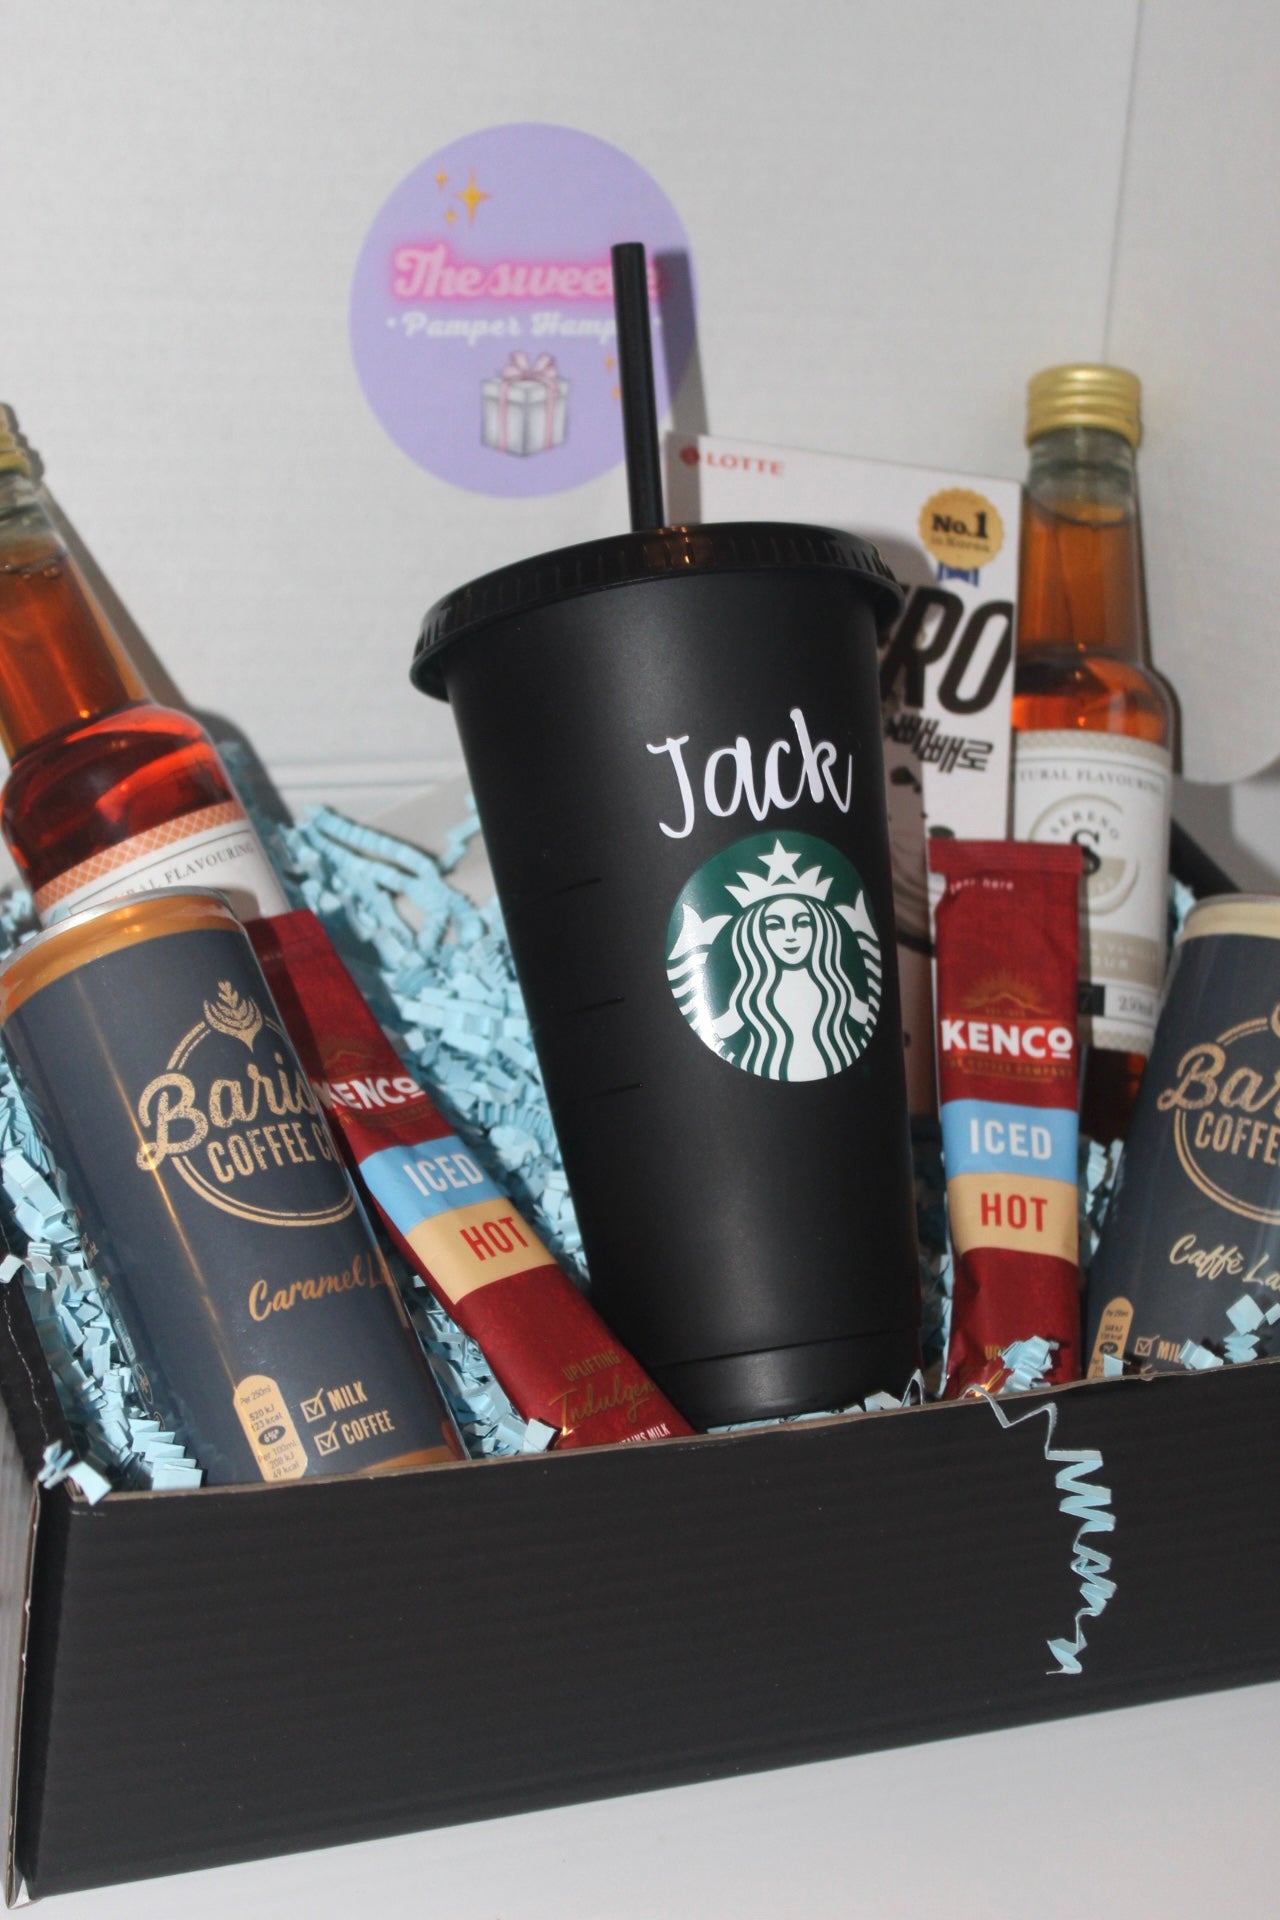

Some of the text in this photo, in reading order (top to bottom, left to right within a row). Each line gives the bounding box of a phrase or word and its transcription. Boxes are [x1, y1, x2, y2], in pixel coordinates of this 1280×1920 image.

[402, 310, 617, 346] Pamper Hamp
[706, 452, 784, 476] LOTTE
[931, 509, 989, 539] No.1
[646, 707, 853, 839] Jack
[1050, 810, 1120, 841] SERENO
[983, 877, 1014, 891] here
[941, 1019, 1073, 1060] KENCO
[311, 1077, 426, 1111] KENCO
[206, 1122, 316, 1184] COFFEE
[970, 1118, 1052, 1160] ICED
[402, 1153, 484, 1196] ICED
[980, 1192, 1048, 1233] HOT
[459, 1216, 529, 1261] HOT
[1169, 1234, 1243, 1280] Caffè
[248, 1254, 365, 1321] Caramel
[562, 1351, 621, 1382] UPLIFTING
[1156, 1340, 1184, 1365] MIL
[264, 1403, 275, 1414] kJ
[327, 1381, 367, 1412] MILK
[250, 1411, 283, 1433] 123 kcal
[341, 1410, 395, 1444] COFFEE
[646, 1422, 671, 1441] MILK
[282, 1461, 299, 1473] kcal
